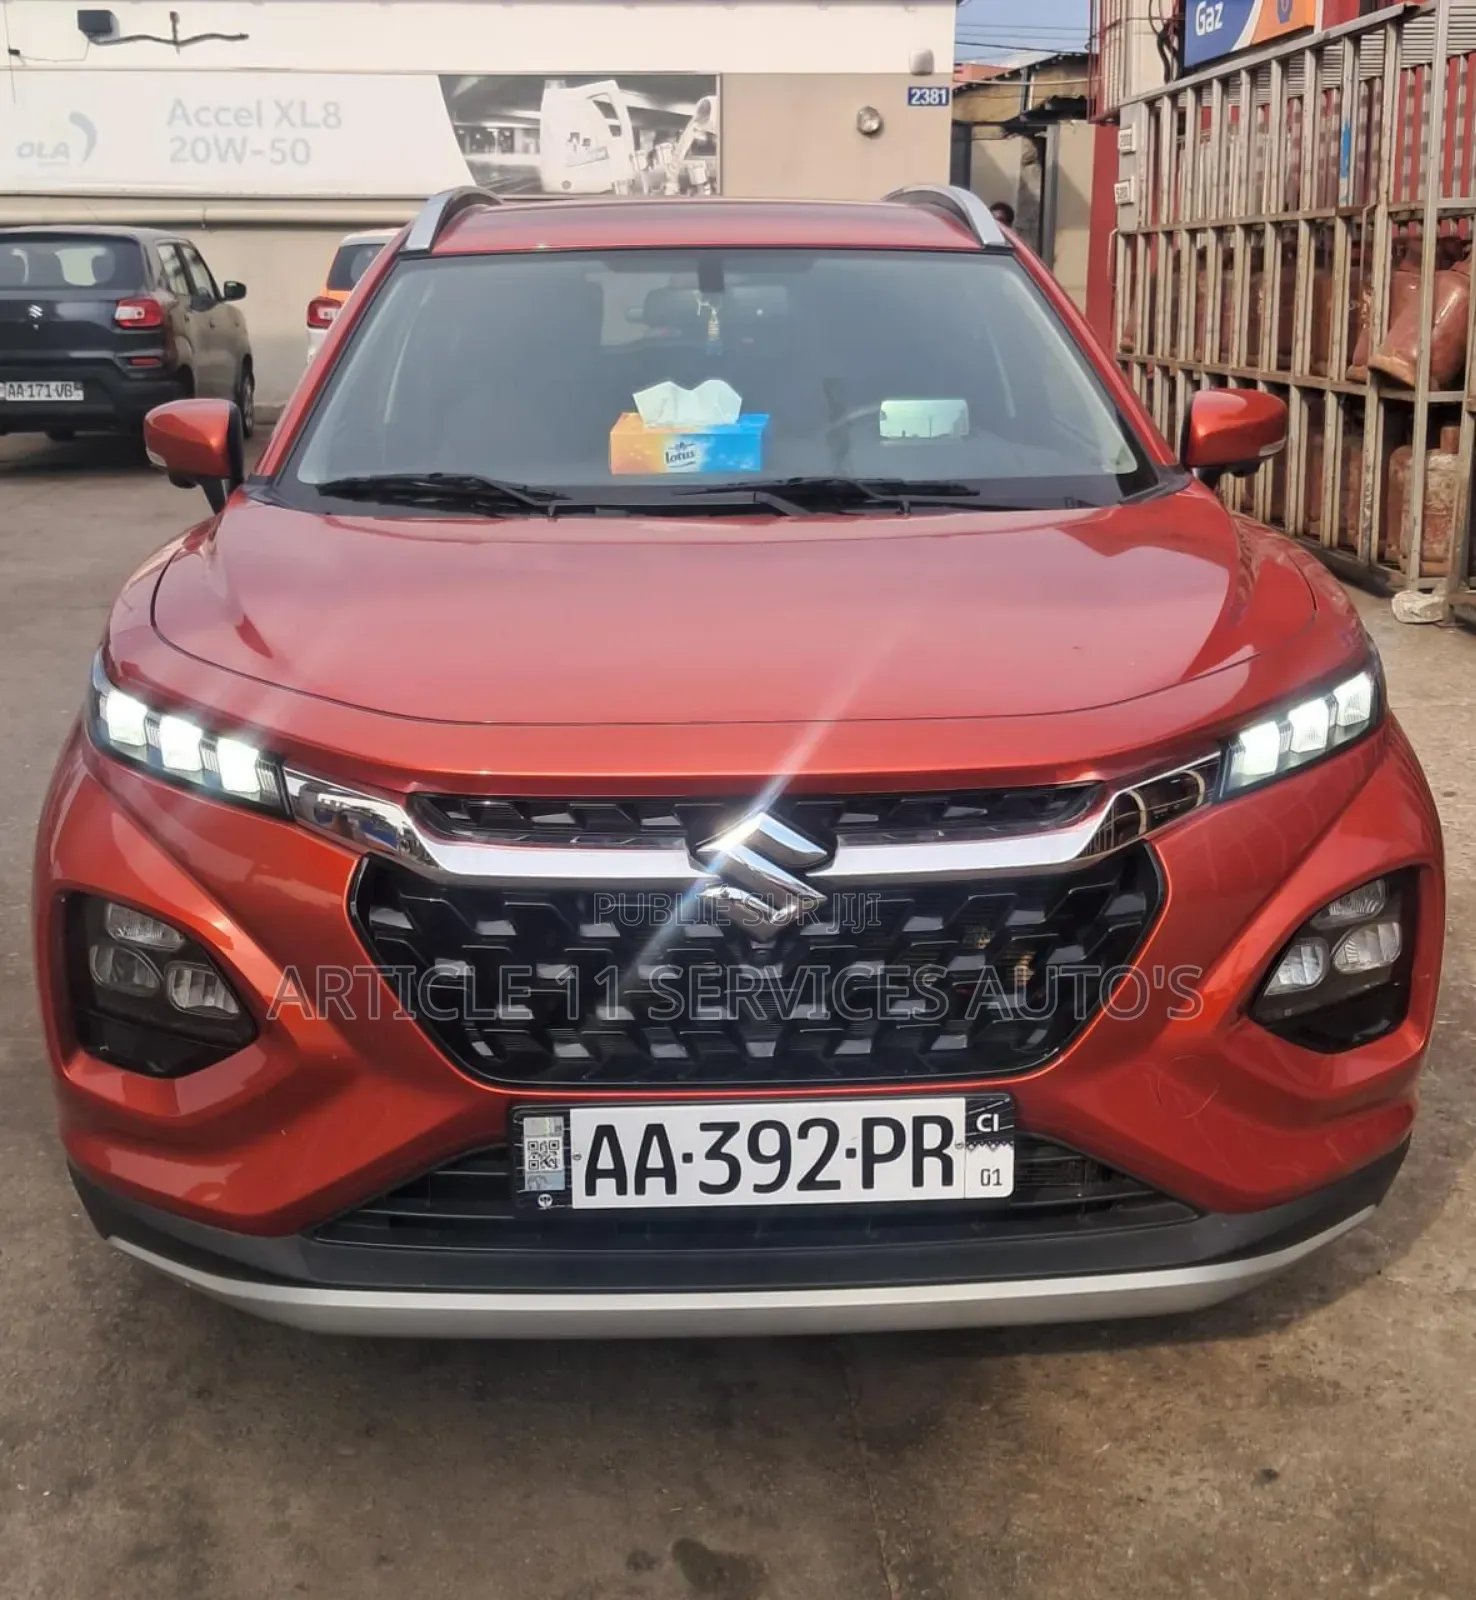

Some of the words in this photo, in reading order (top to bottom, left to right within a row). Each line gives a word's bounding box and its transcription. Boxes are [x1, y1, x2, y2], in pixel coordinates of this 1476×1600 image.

[1195, 0, 1224, 36] Gaz
[911, 88, 946, 105] 2381
[166, 97, 263, 129] Accel
[273, 99, 342, 130] XL8
[16, 140, 70, 160] OLA
[169, 136, 311, 166] 20W-50
[976, 1113, 999, 1132] CI
[980, 1168, 1003, 1187] 01
